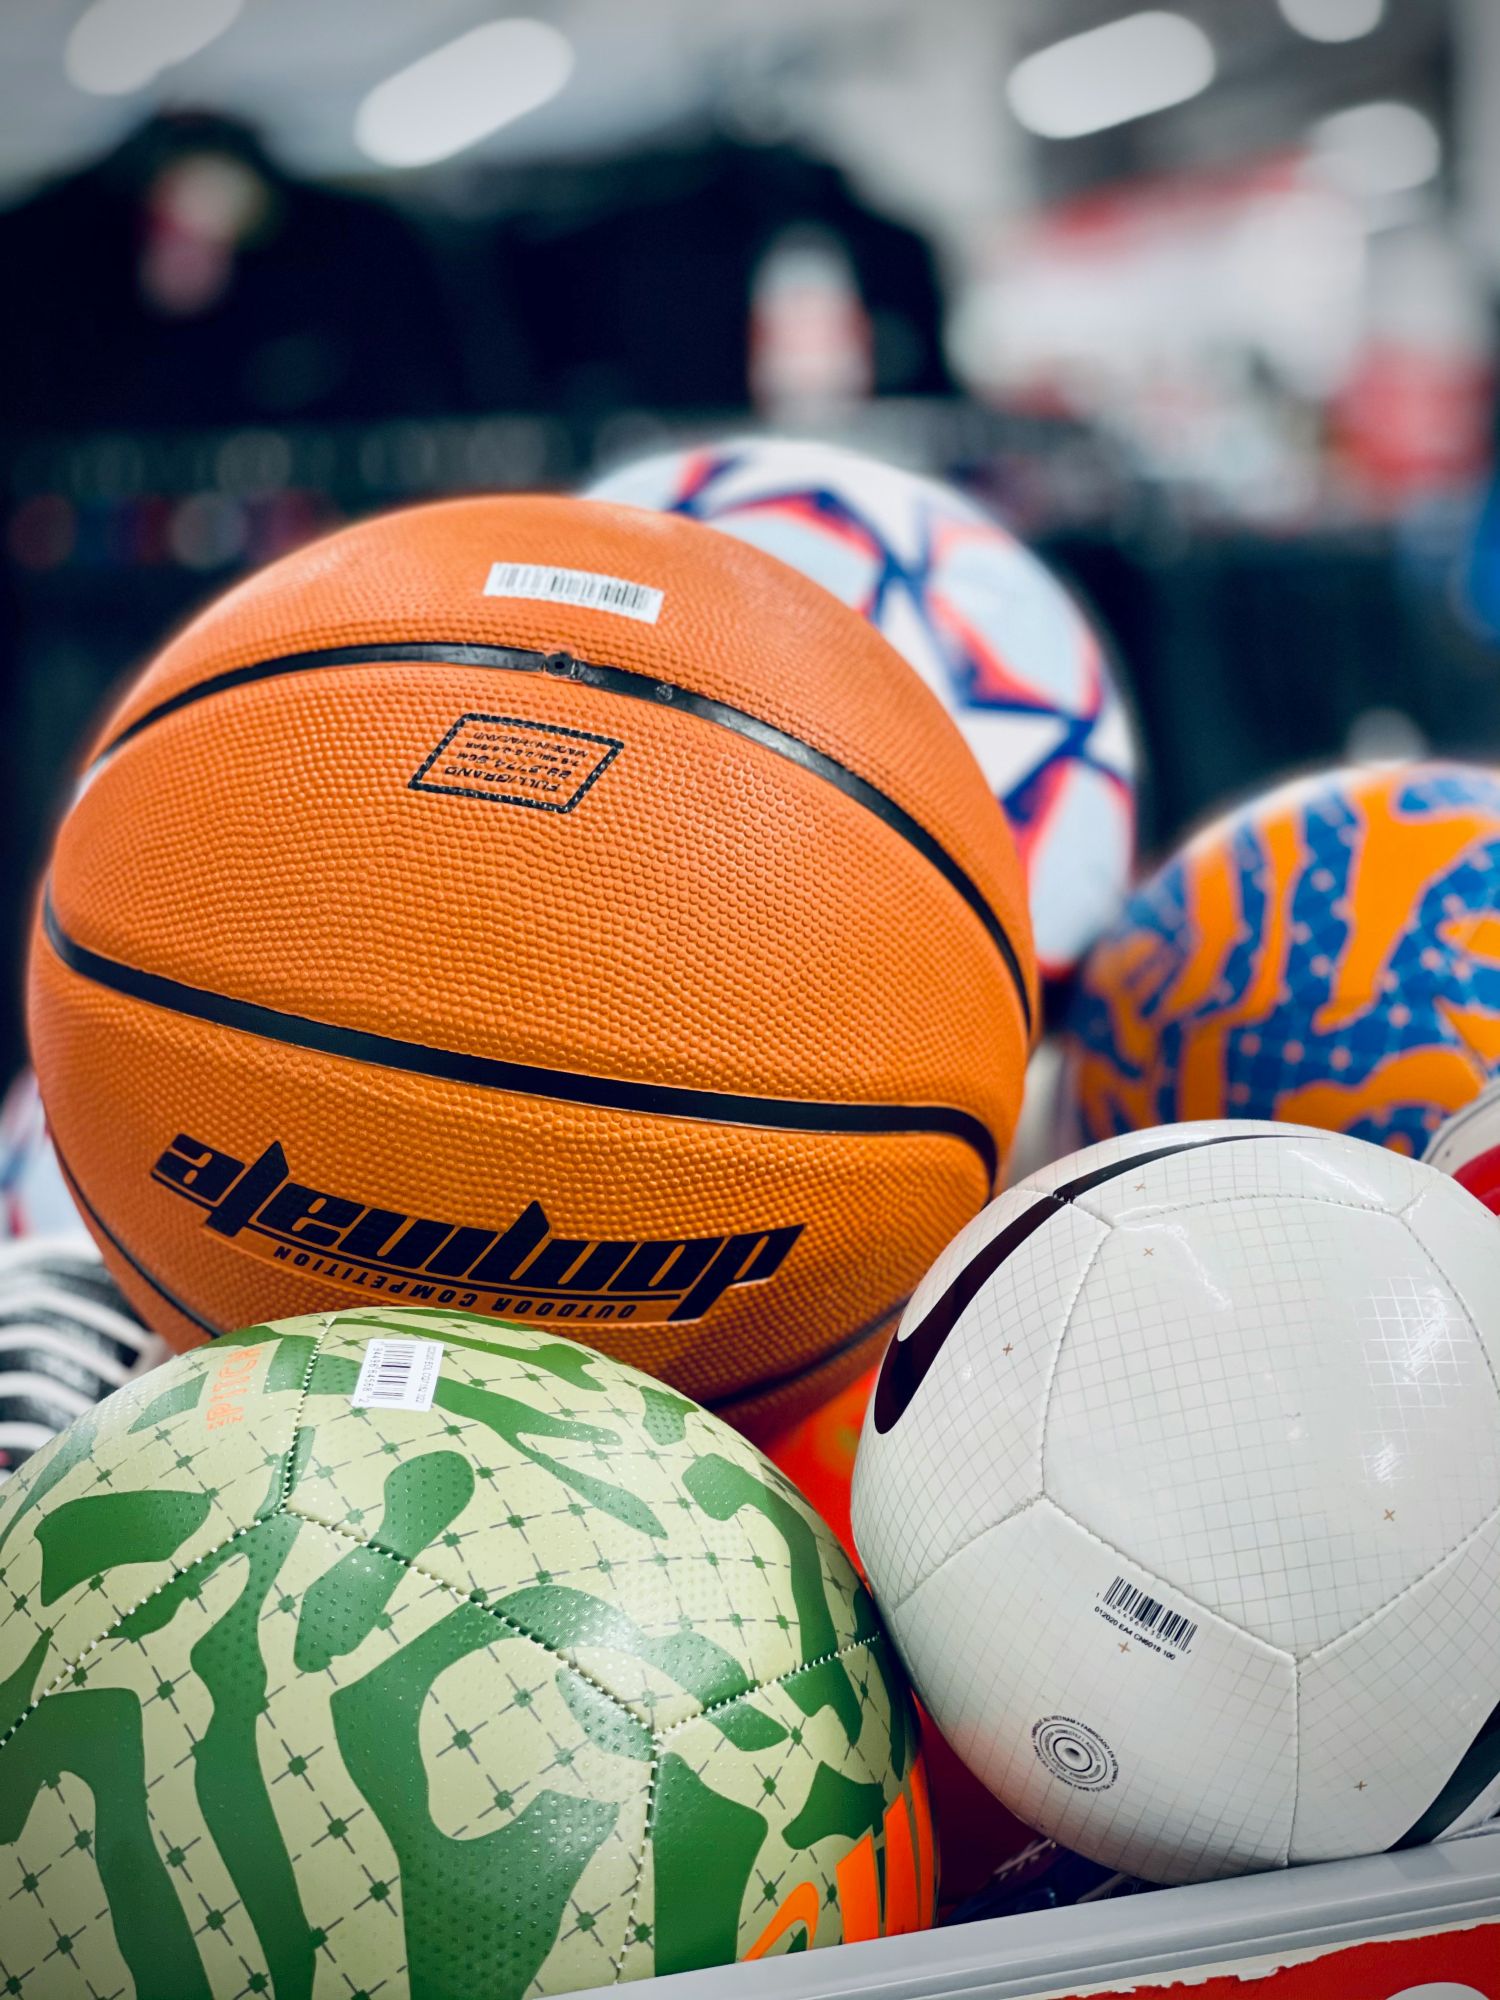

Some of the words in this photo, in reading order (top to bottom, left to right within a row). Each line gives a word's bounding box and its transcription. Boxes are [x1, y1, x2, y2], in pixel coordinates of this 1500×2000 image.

[150, 1133, 805, 1322] dominate
[271, 1244, 479, 1308] COMPETITION
[492, 1294, 638, 1321] OUTDOOR
[1094, 1605, 1119, 1627] 012020
[1163, 1650, 1176, 1661] 100
